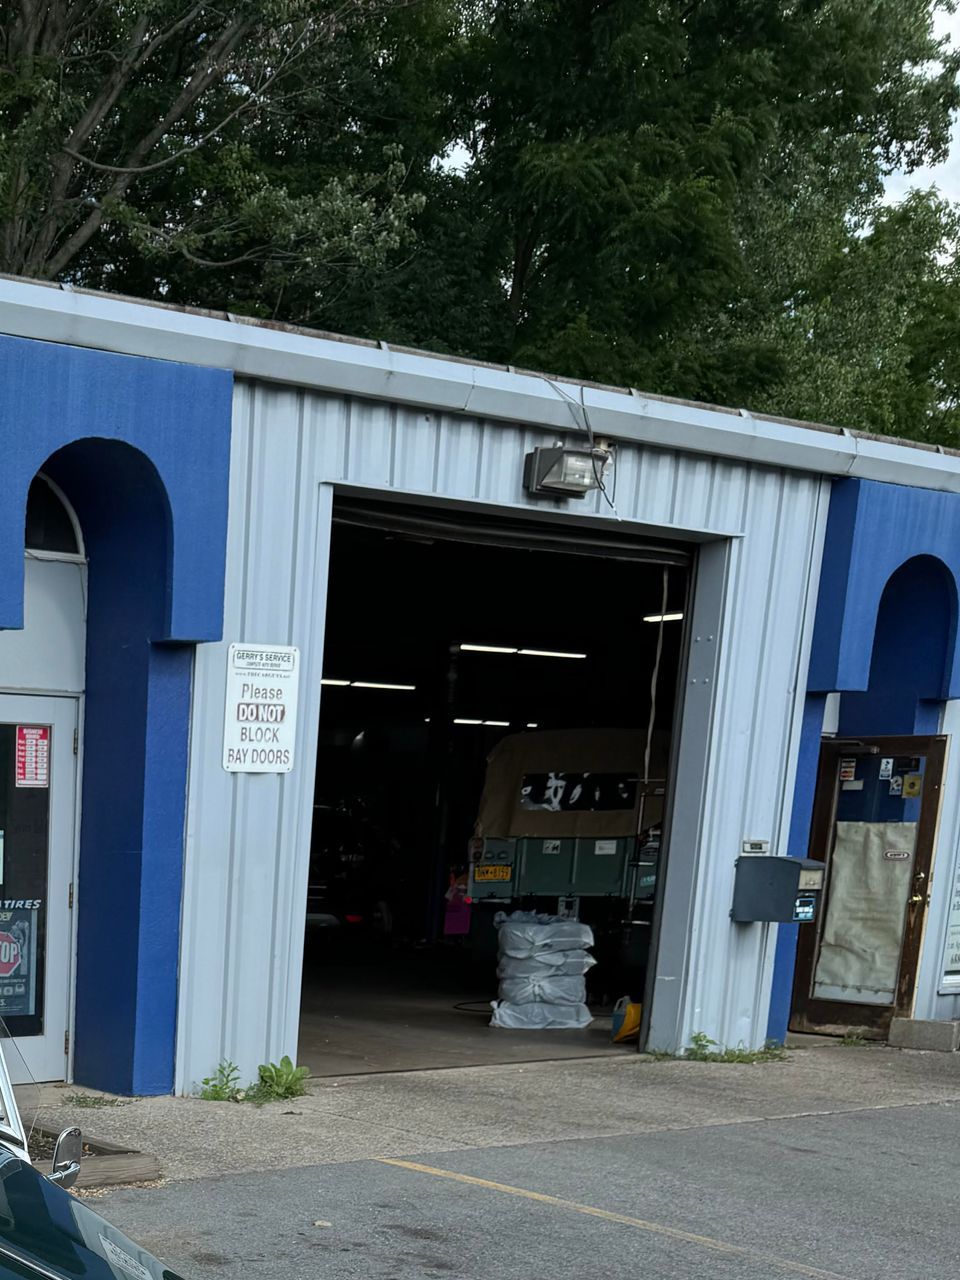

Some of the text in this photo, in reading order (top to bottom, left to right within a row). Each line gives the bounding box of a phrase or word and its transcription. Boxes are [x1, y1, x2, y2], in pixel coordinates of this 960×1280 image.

[265, 653, 292, 663] SERVICE
[242, 683, 283, 700] Please
[239, 704, 284, 723] DO NOT
[240, 726, 280, 743] BLOCK
[228, 748, 290, 765] BAY DOORS
[3, 899, 41, 909] TIRES
